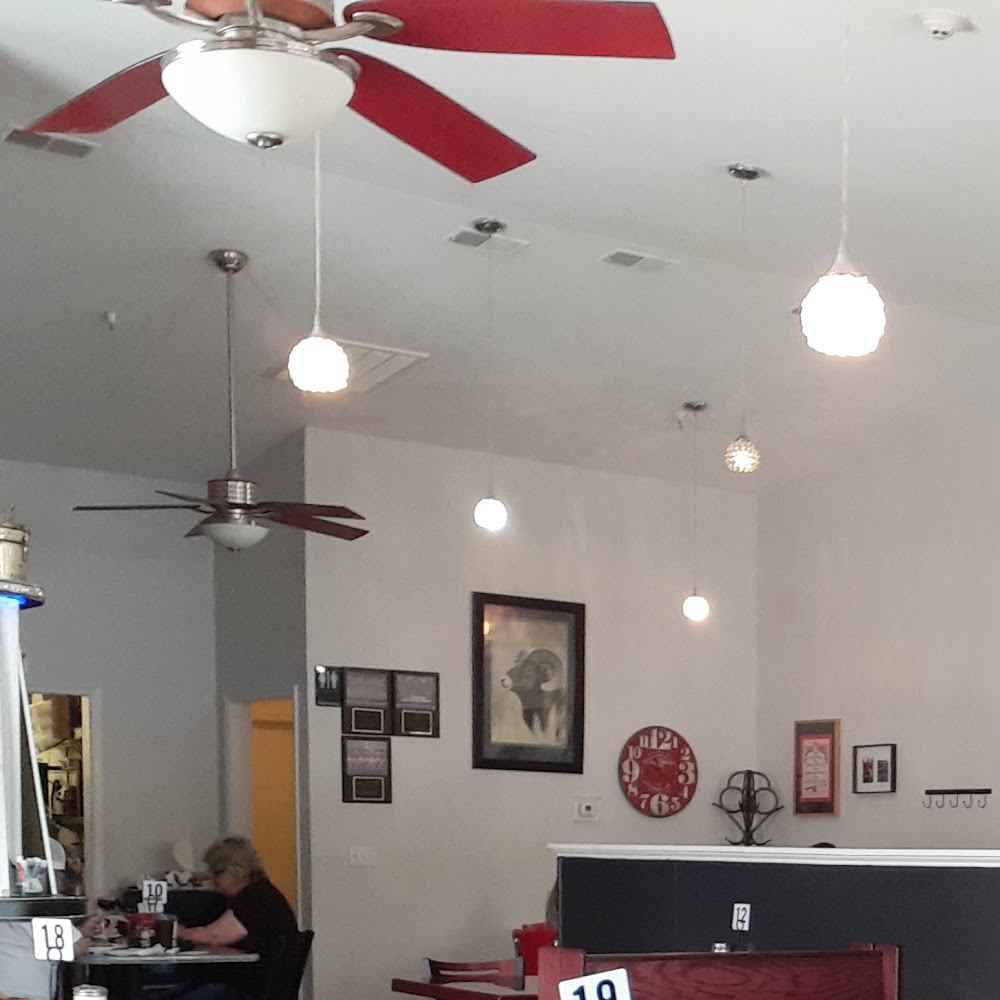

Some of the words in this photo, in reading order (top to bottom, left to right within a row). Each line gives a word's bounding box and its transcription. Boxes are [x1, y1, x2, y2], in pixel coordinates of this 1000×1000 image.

[650, 728, 672, 750] 12
[628, 745, 641, 759] 10
[680, 747, 691, 760] 2
[621, 758, 640, 783] 9
[678, 761, 695, 784] 3
[640, 793, 650, 809] 7
[650, 793, 670, 816] 6
[147, 883, 163, 898] 10
[736, 907, 747, 923] 12
[41, 924, 65, 949] 18
